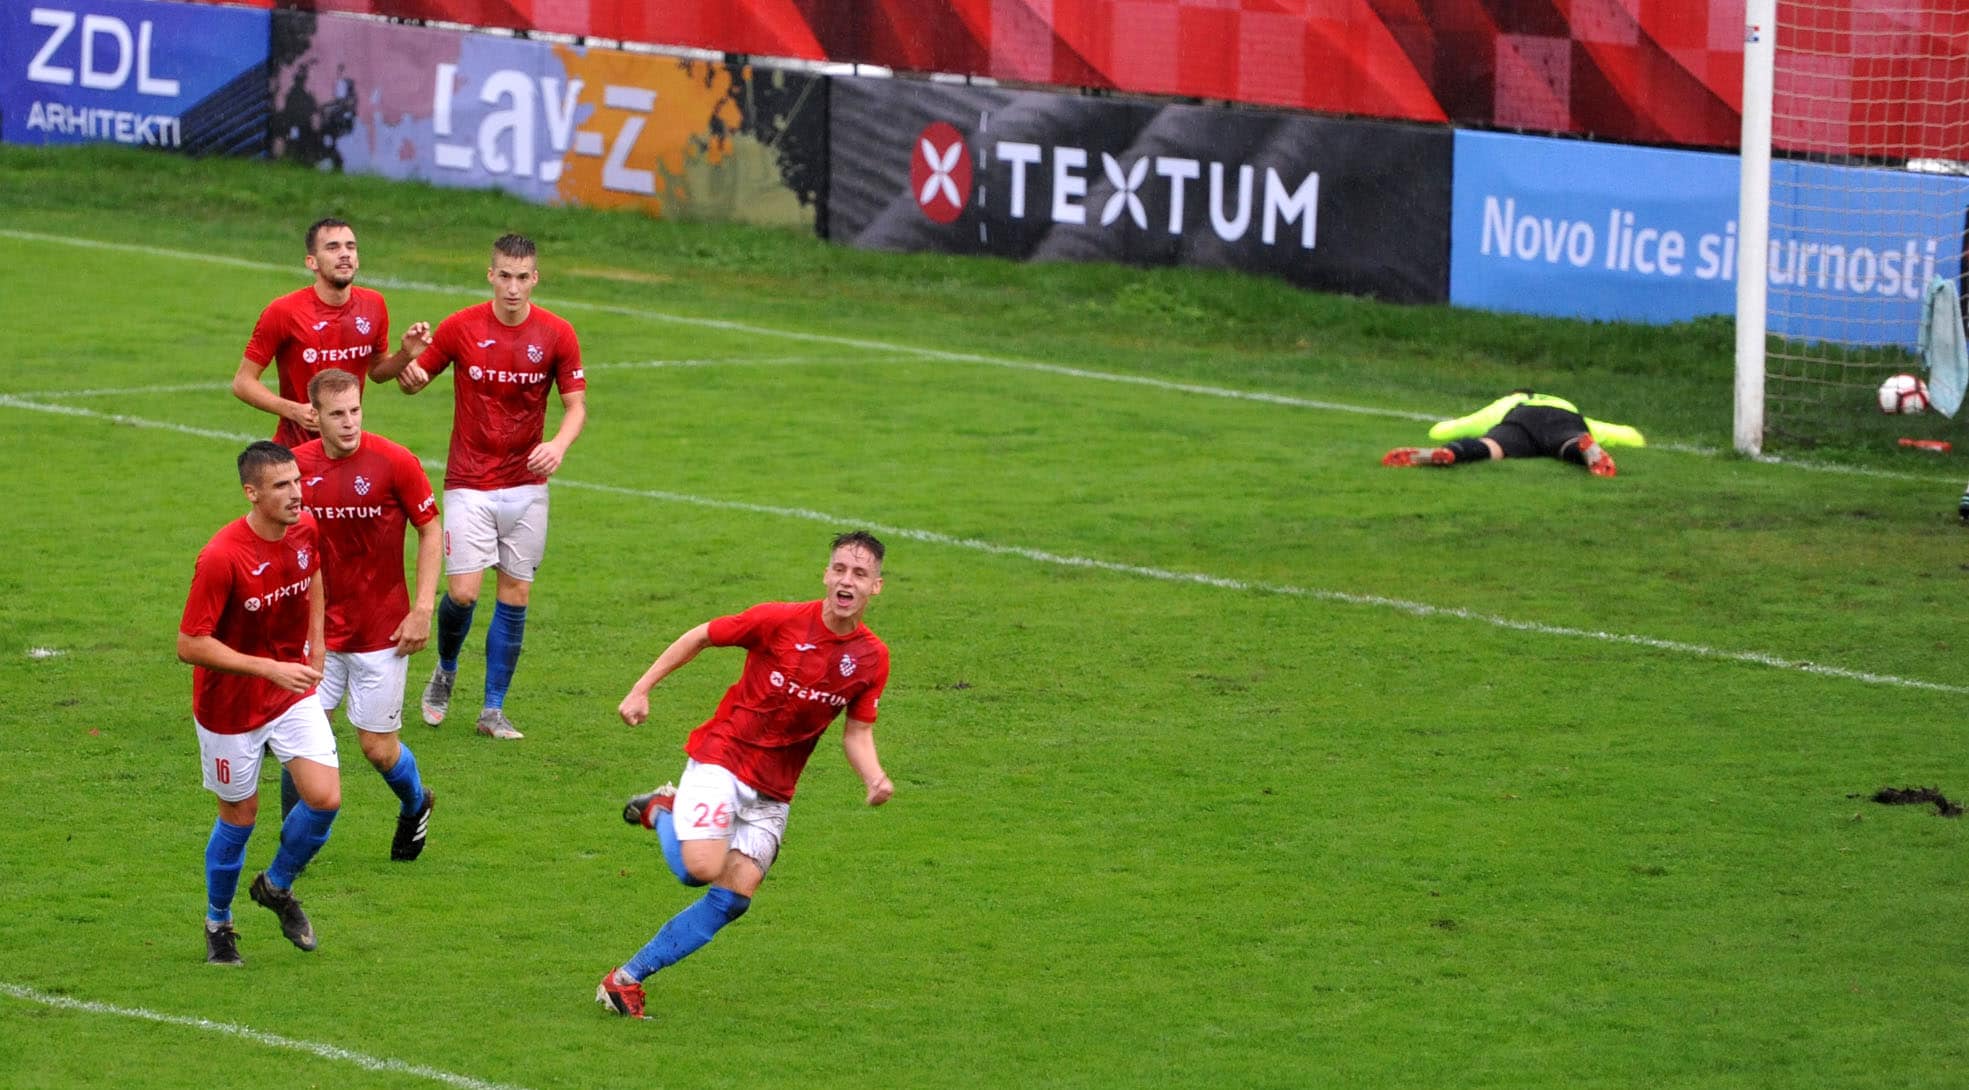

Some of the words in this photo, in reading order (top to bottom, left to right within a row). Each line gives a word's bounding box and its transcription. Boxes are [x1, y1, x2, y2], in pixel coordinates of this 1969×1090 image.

[27, 9, 180, 97] ZDL
[26, 101, 181, 147] ARHITEKTI
[996, 141, 1320, 249] TEXTUM
[1480, 196, 1594, 268] Novo
[1606, 209, 1686, 276] lice
[1696, 221, 1937, 299] siurnosti
[315, 506, 382, 519] TEXTUM
[215, 758, 230, 784] 16
[693, 802, 730, 828] 26
